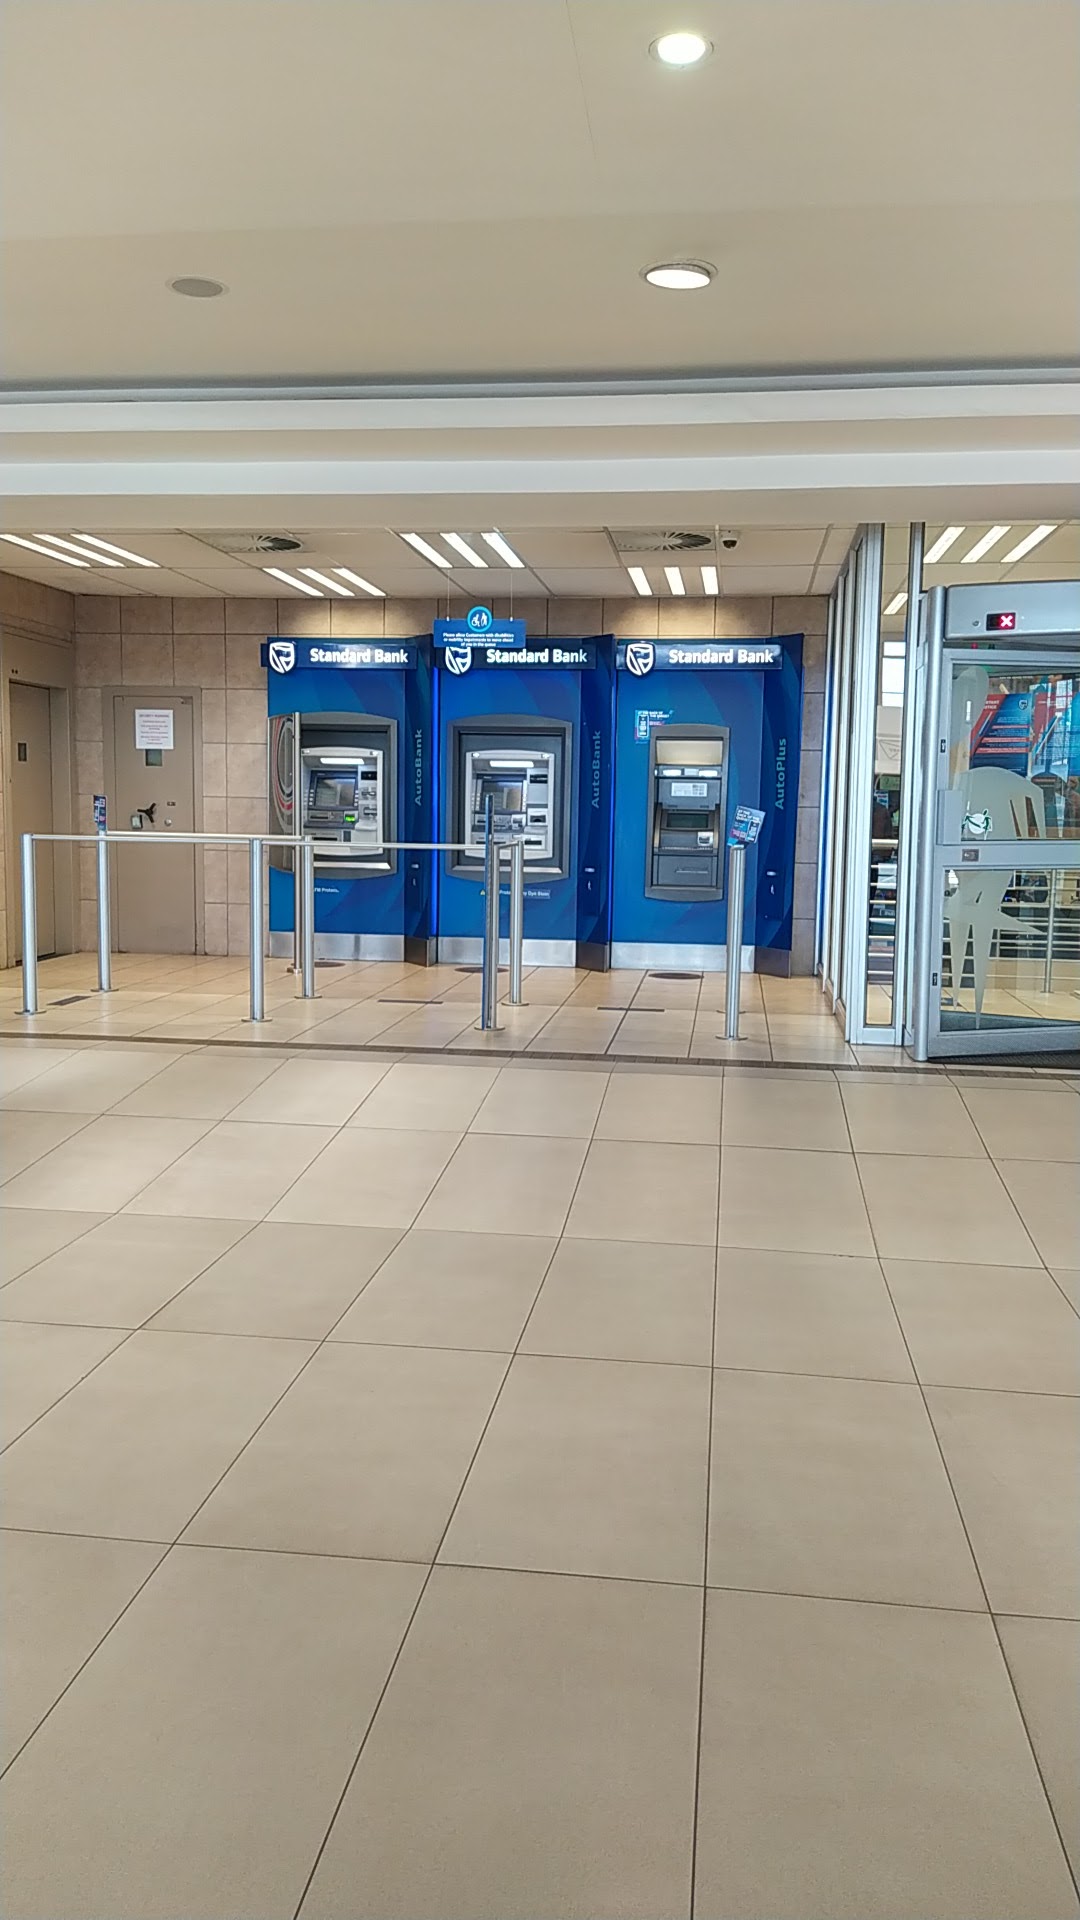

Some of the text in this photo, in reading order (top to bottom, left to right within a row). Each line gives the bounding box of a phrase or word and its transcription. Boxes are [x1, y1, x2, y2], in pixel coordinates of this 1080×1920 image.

[309, 648, 408, 663] Standard Bank
[486, 648, 587, 663] Standard Bank
[668, 649, 774, 664] Standard Bank
[592, 731, 601, 808] AutoBank
[775, 738, 787, 810] AutoPlus
